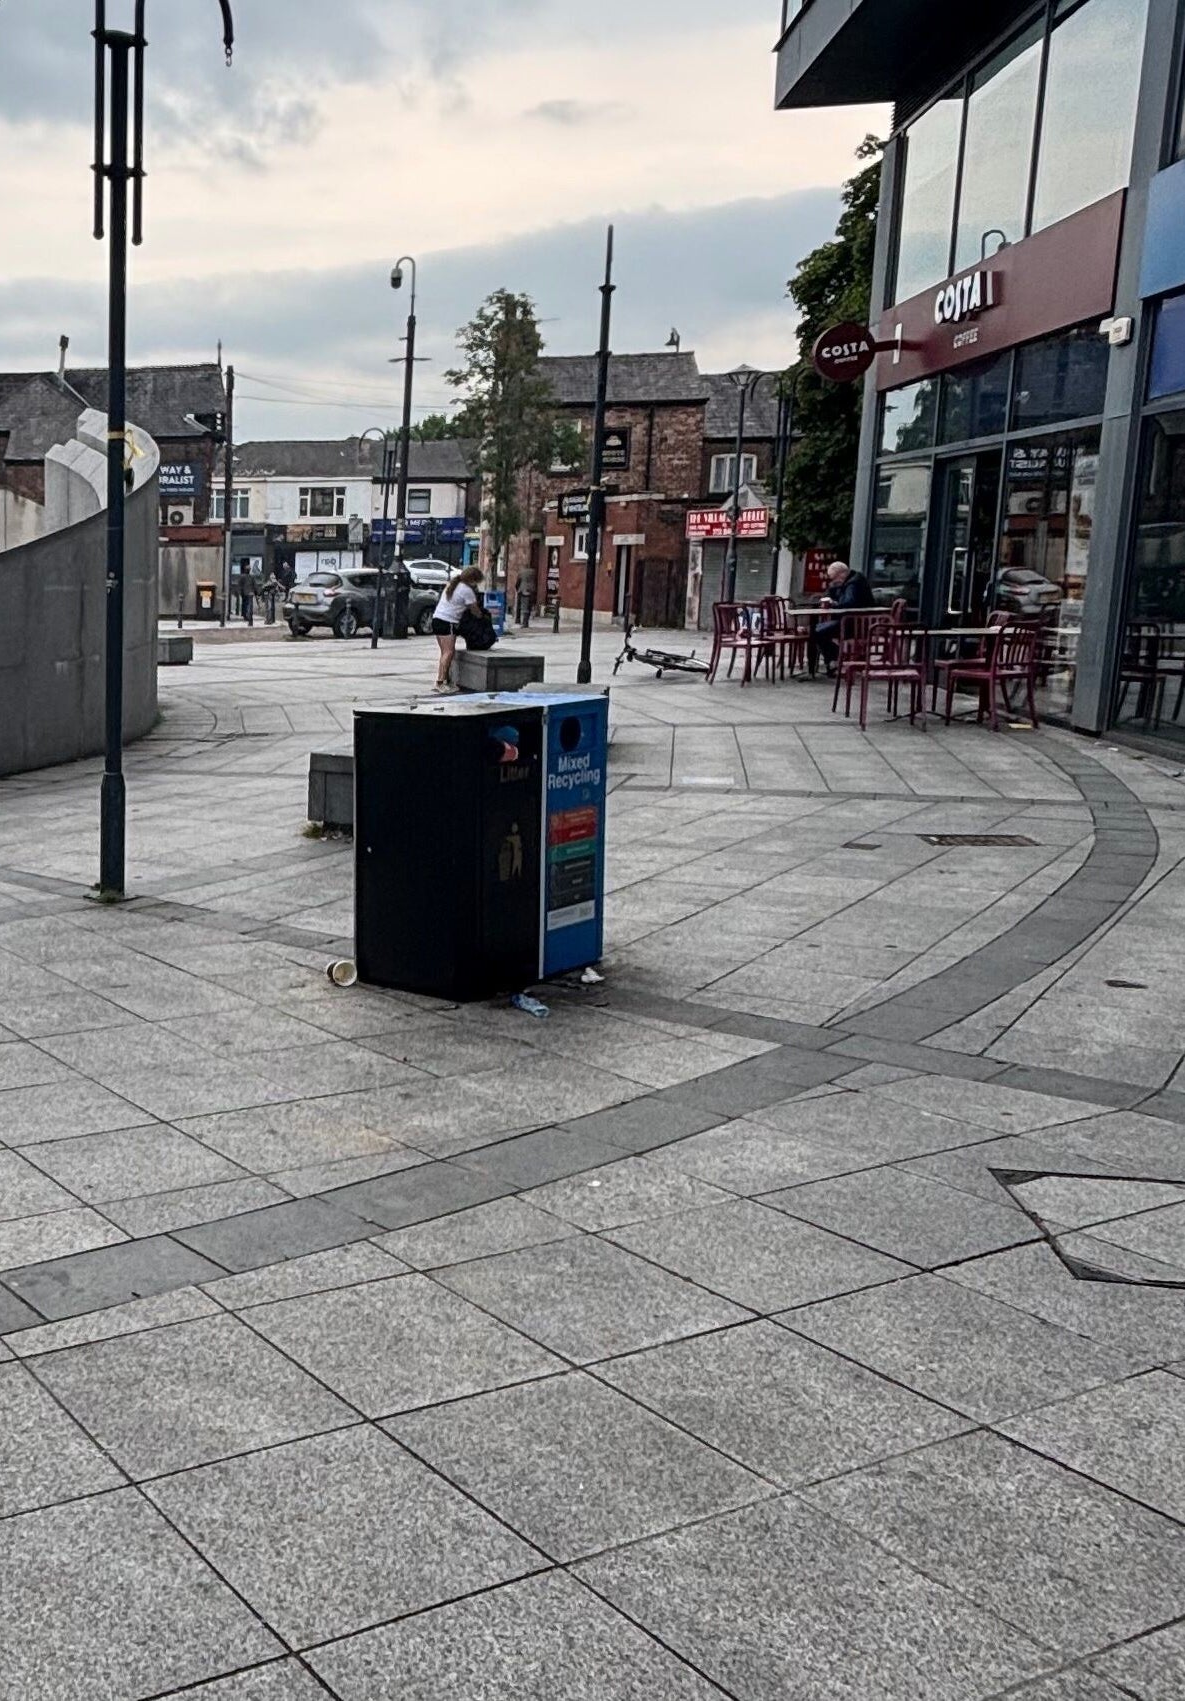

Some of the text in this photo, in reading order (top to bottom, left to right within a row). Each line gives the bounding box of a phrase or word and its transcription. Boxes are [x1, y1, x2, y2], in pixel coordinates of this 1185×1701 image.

[934, 270, 981, 325] COSTA
[821, 341, 870, 358] COSTA
[183, 465, 192, 475] &
[558, 752, 590, 773] Mixed
[548, 768, 601, 790] Recycling
